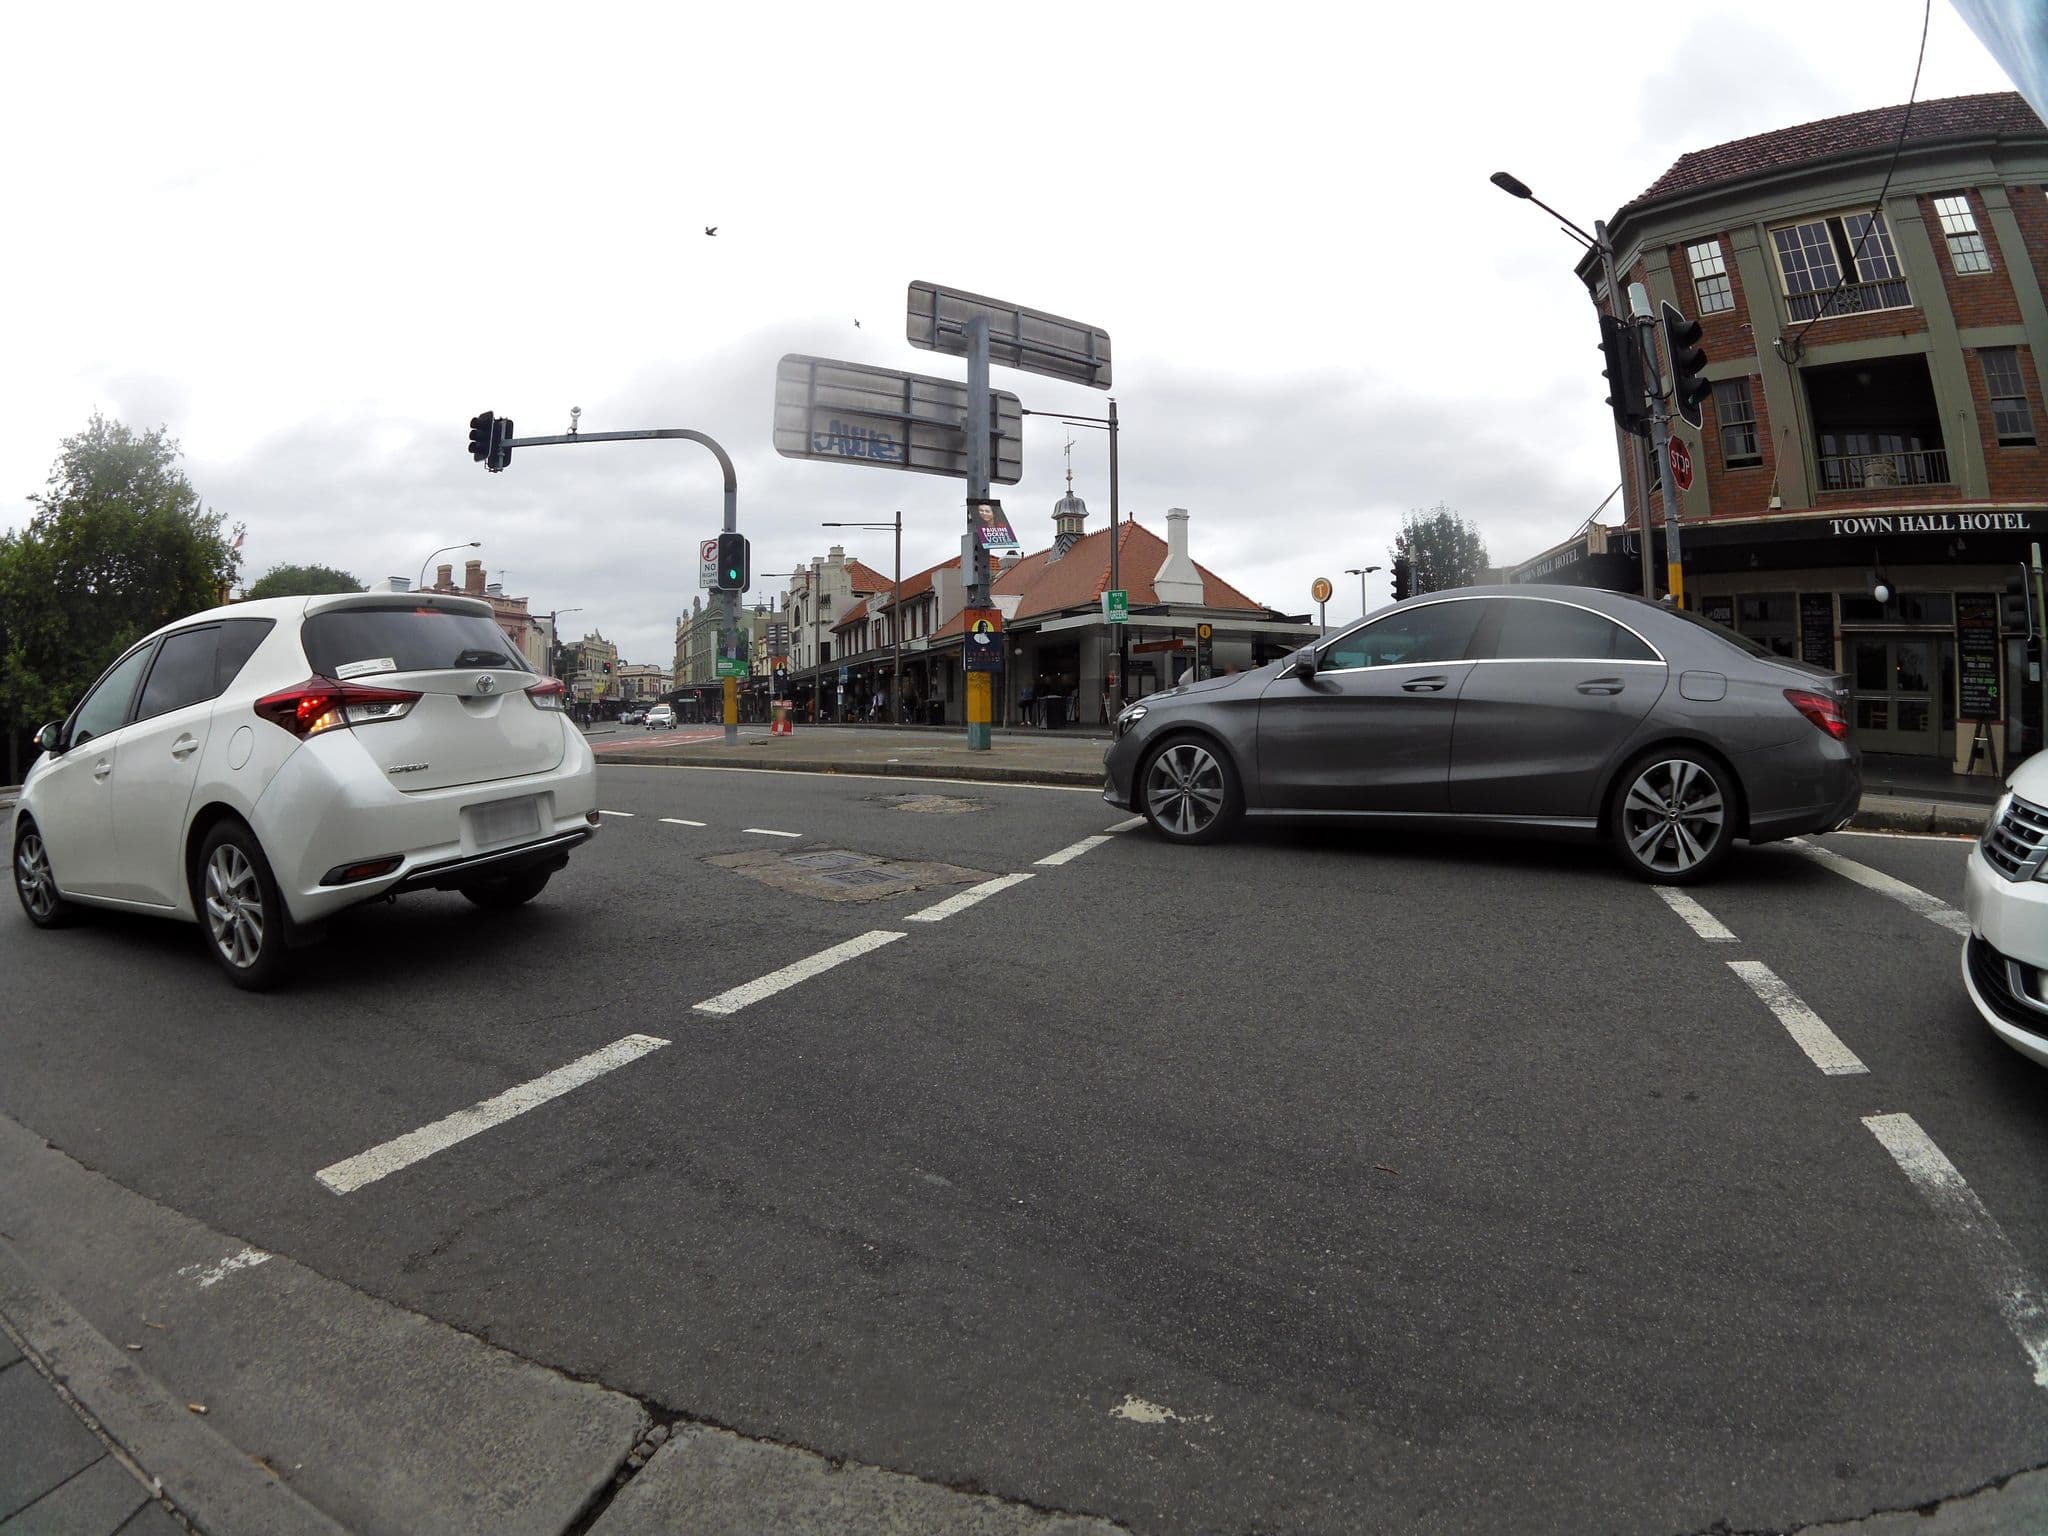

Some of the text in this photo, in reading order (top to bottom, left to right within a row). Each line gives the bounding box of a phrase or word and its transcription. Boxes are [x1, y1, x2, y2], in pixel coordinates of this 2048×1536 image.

[1671, 450, 1690, 474] STOP
[1829, 513, 2031, 535] TOWN HALL HOTEL
[704, 563, 717, 571] NO
[1537, 561, 1554, 577] HALL
[1554, 548, 1580, 569] HOTEL
[1110, 609, 1128, 620] GREENS
